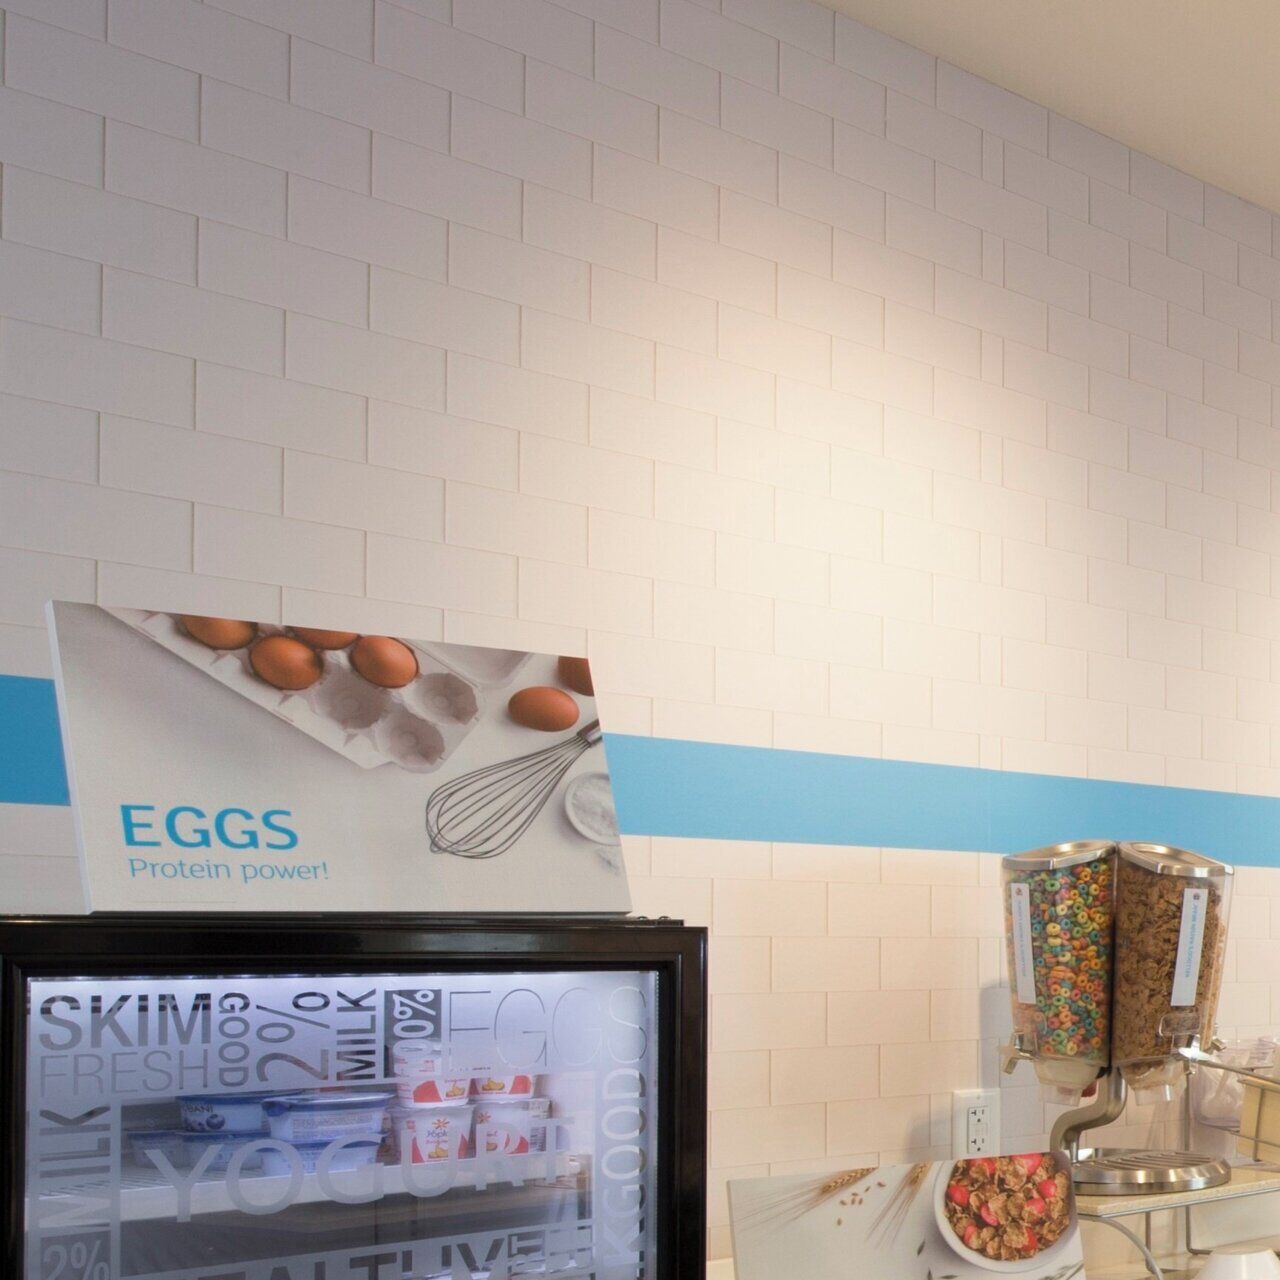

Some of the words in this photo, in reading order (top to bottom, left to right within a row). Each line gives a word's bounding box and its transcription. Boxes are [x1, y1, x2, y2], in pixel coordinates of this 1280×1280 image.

[120, 804, 298, 850] EGGS
[129, 858, 231, 880] Protein
[239, 861, 330, 884] power!
[39, 992, 212, 1051] SKIM
[218, 992, 251, 1087] GOOD
[256, 991, 331, 1082] 2%
[336, 988, 377, 1081] MILK
[449, 985, 648, 1074] EGGS
[40, 1048, 209, 1098] FRESH
[39, 1104, 111, 1230] MILK
[143, 1117, 576, 1223] YOGURT
